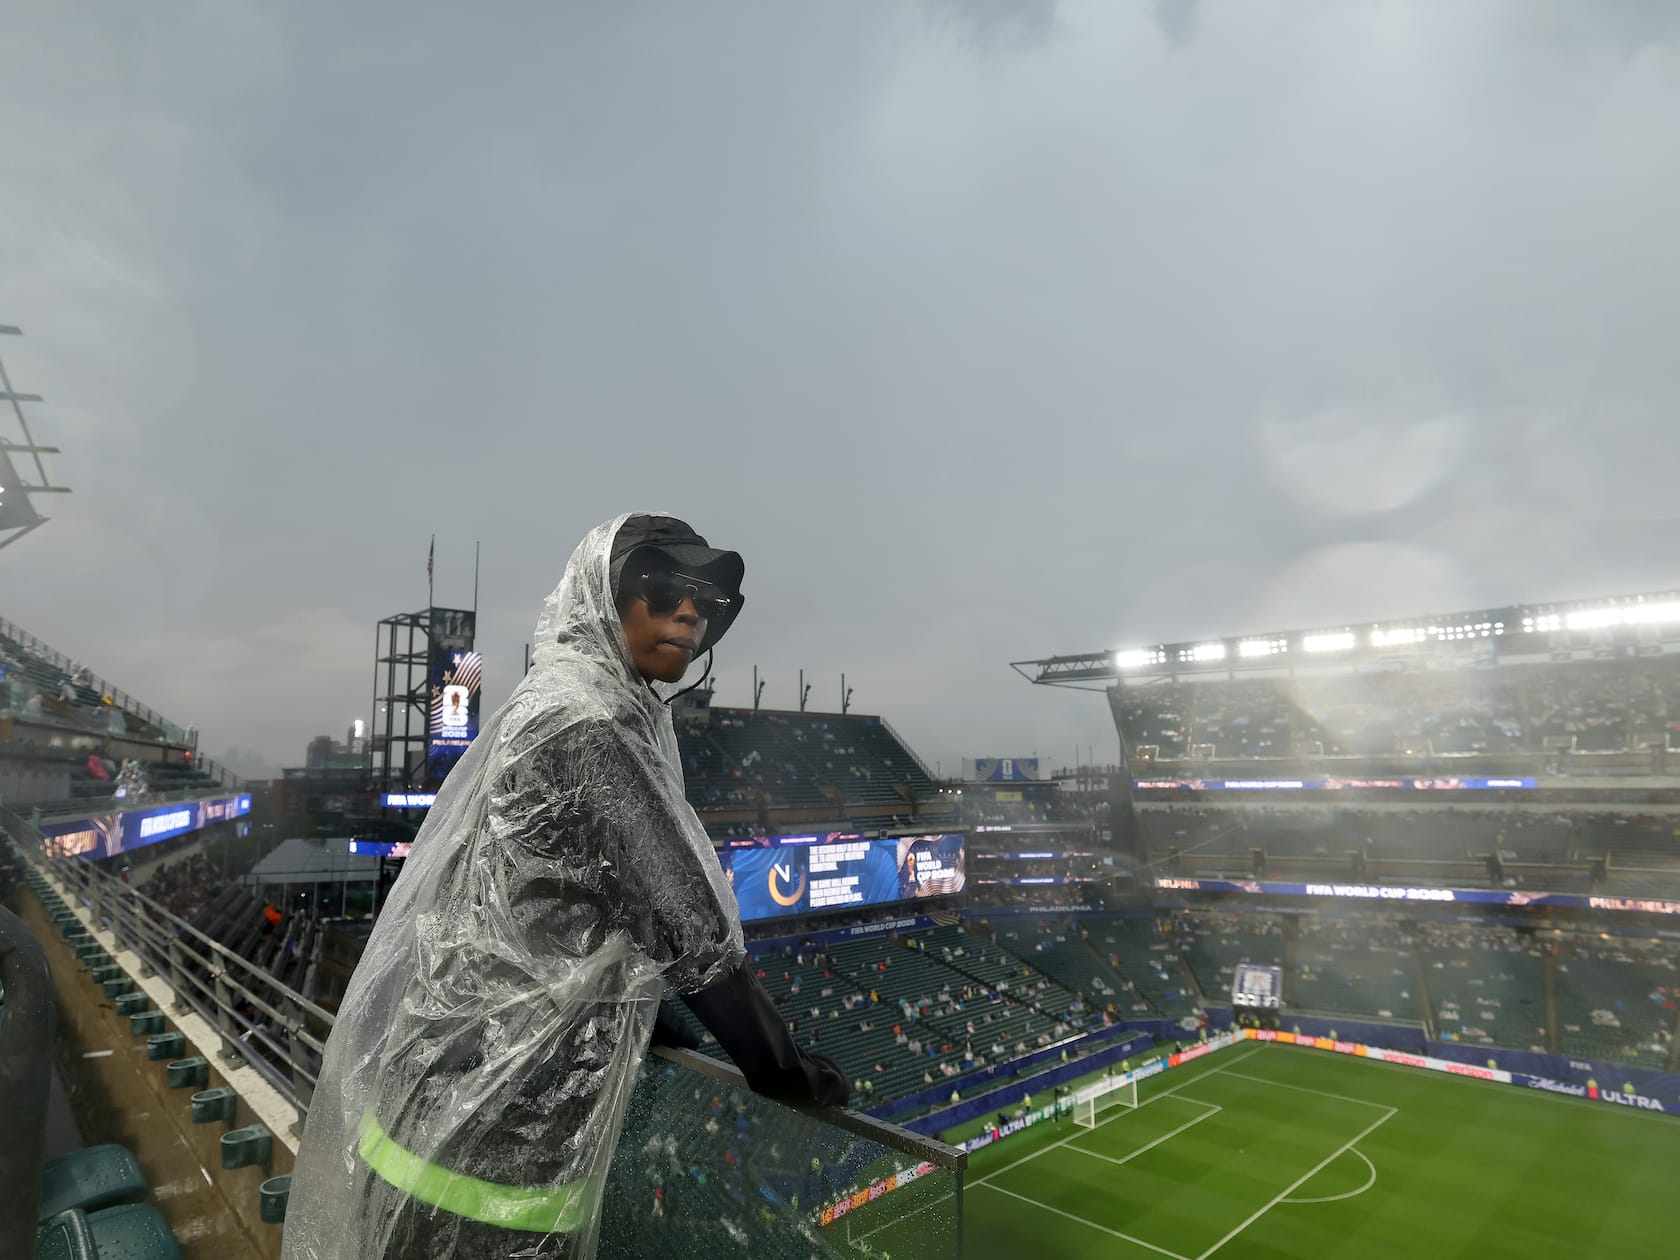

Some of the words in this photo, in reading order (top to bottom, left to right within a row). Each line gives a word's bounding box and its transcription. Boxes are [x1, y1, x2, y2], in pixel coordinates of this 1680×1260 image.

[387, 795, 407, 805] FIFA
[407, 795, 436, 805] WOR
[916, 851, 932, 862] FIFA
[917, 860, 942, 872] WORLD
[917, 871, 931, 882] CUP
[1306, 884, 1333, 895] FIFA
[1333, 885, 1379, 897] WORLD
[1380, 887, 1406, 899] CUP
[1406, 888, 1454, 901] 2026
[850, 927, 864, 935] FIFA
[864, 923, 885, 933] WORLD
[885, 921, 896, 930] CUP
[1383, 1052, 1426, 1067] verizon
[1569, 1060, 1592, 1071] FIFA
[1446, 1064, 1494, 1080] verizon
[1601, 1089, 1664, 1112] ULTRA
[999, 1117, 1025, 1138] ULTRA
